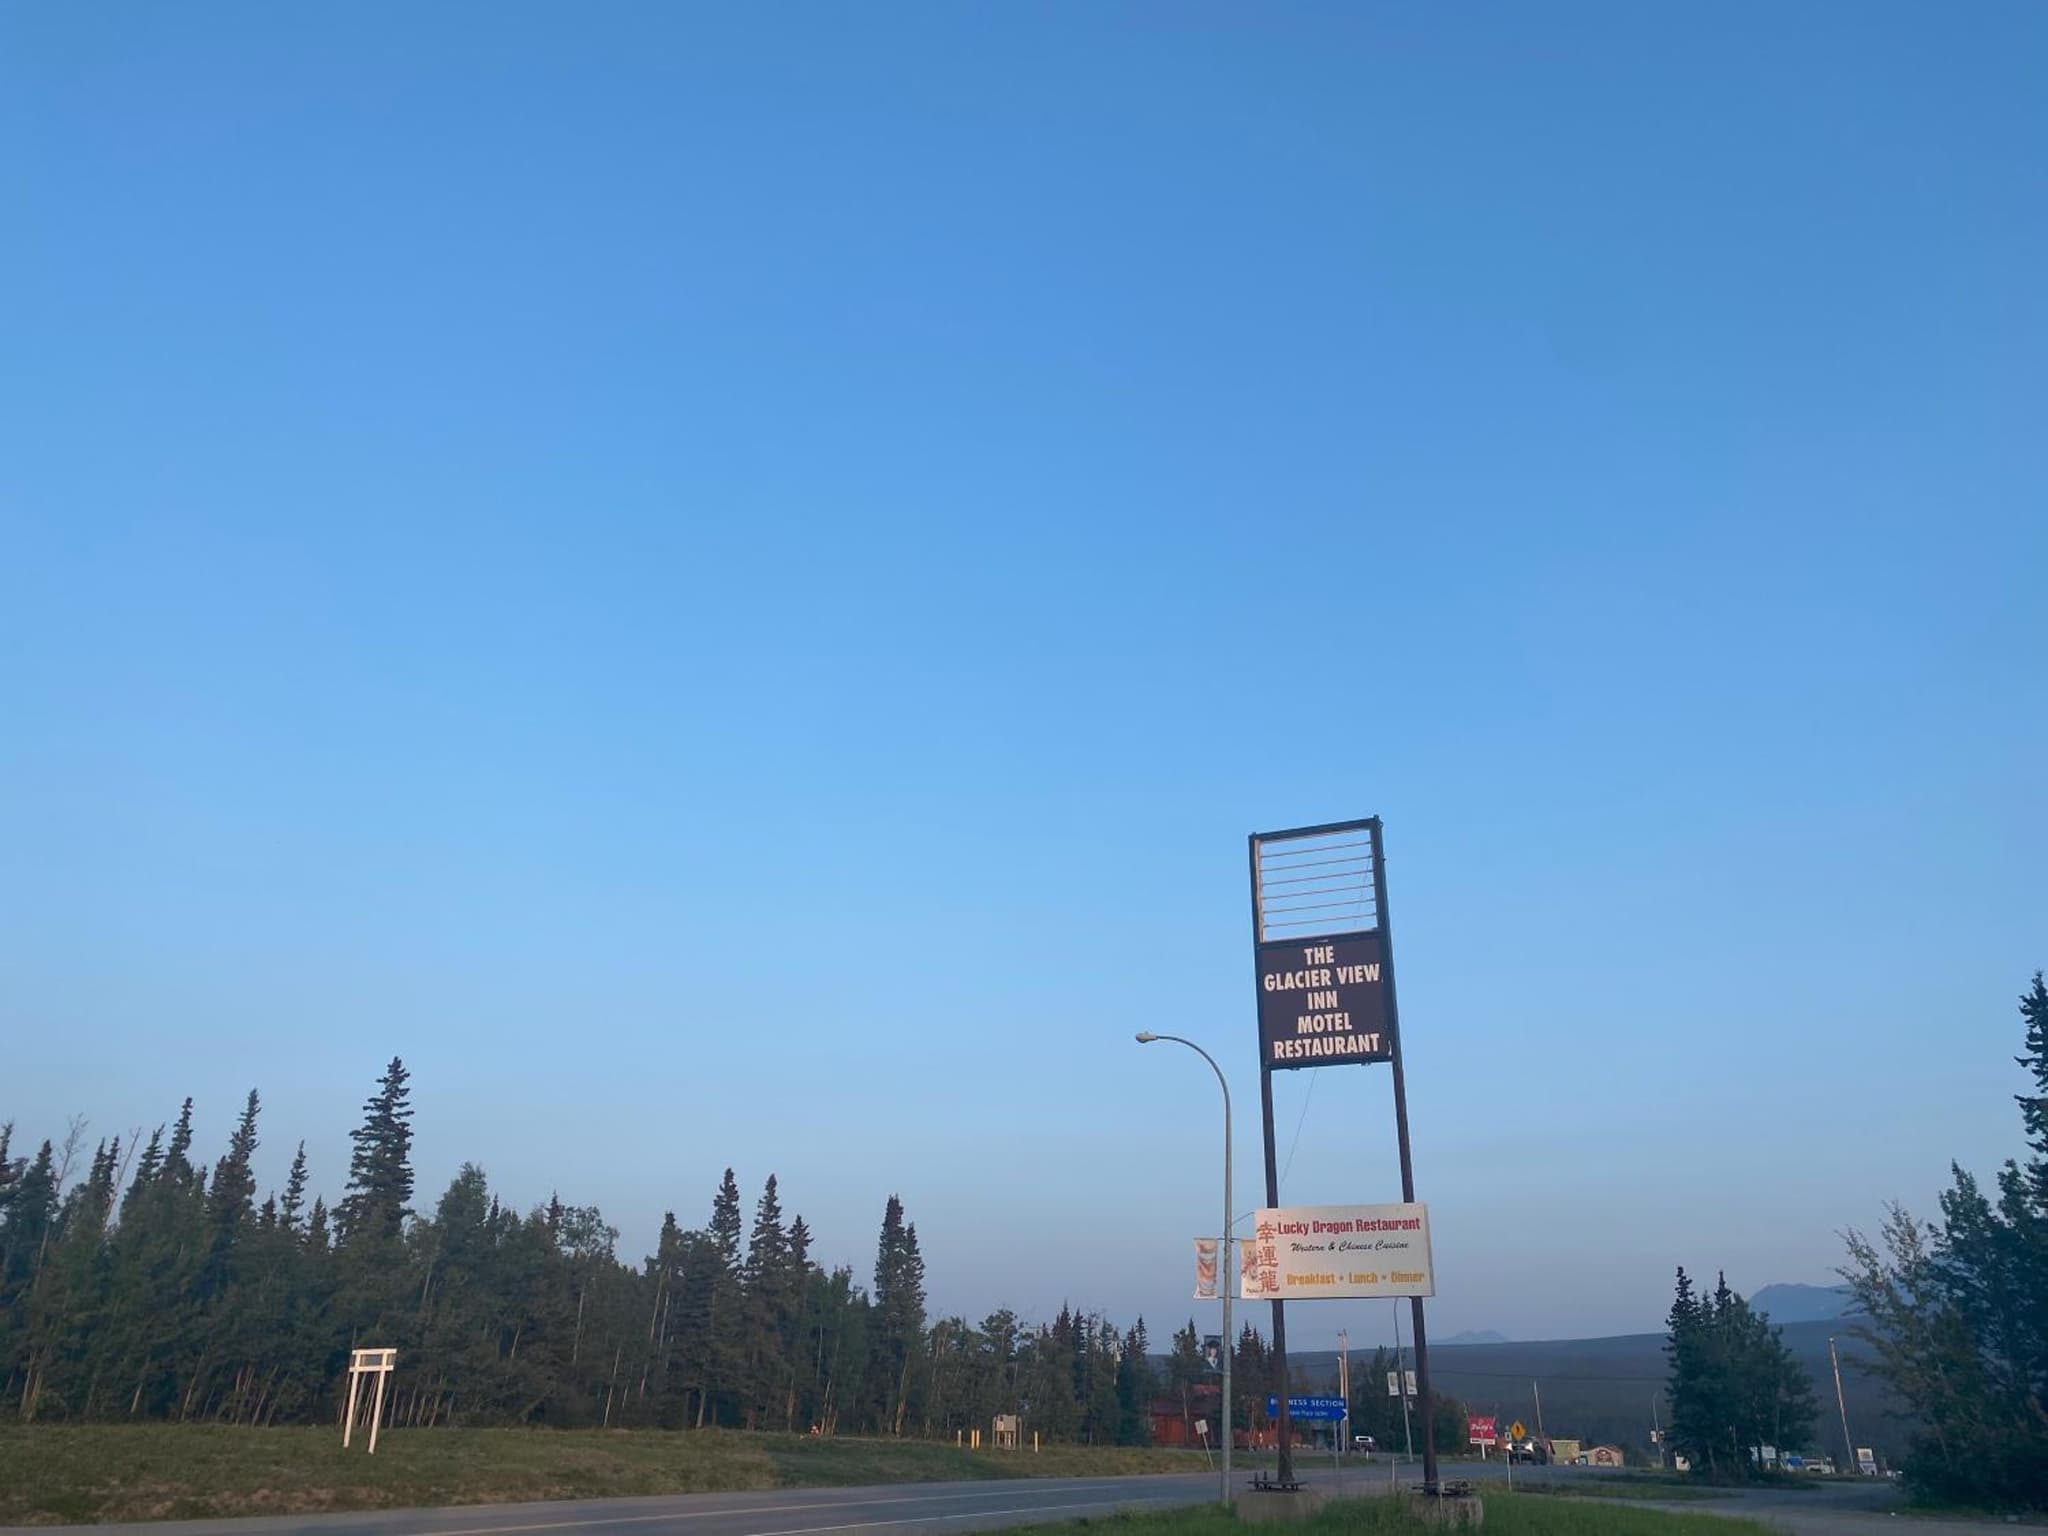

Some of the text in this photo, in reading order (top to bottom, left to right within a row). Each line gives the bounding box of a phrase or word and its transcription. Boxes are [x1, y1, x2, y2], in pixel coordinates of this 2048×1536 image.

[1304, 946, 1334, 965] THE
[1264, 964, 1380, 992] GLACIER VIEW
[1307, 991, 1338, 1010] INN
[1297, 1013, 1352, 1034] MOTEL
[1274, 1033, 1380, 1059] RESTAURANT
[1277, 1217, 1421, 1236] Lucky Dragon Restaurant
[1290, 1239, 1409, 1252] Western & Chinese Cuisine
[1257, 1220, 1280, 1293] 幸運龍
[1287, 1270, 1425, 1285] Breakfast Lunch Dinner
[1310, 1399, 1345, 1408] SECTION
